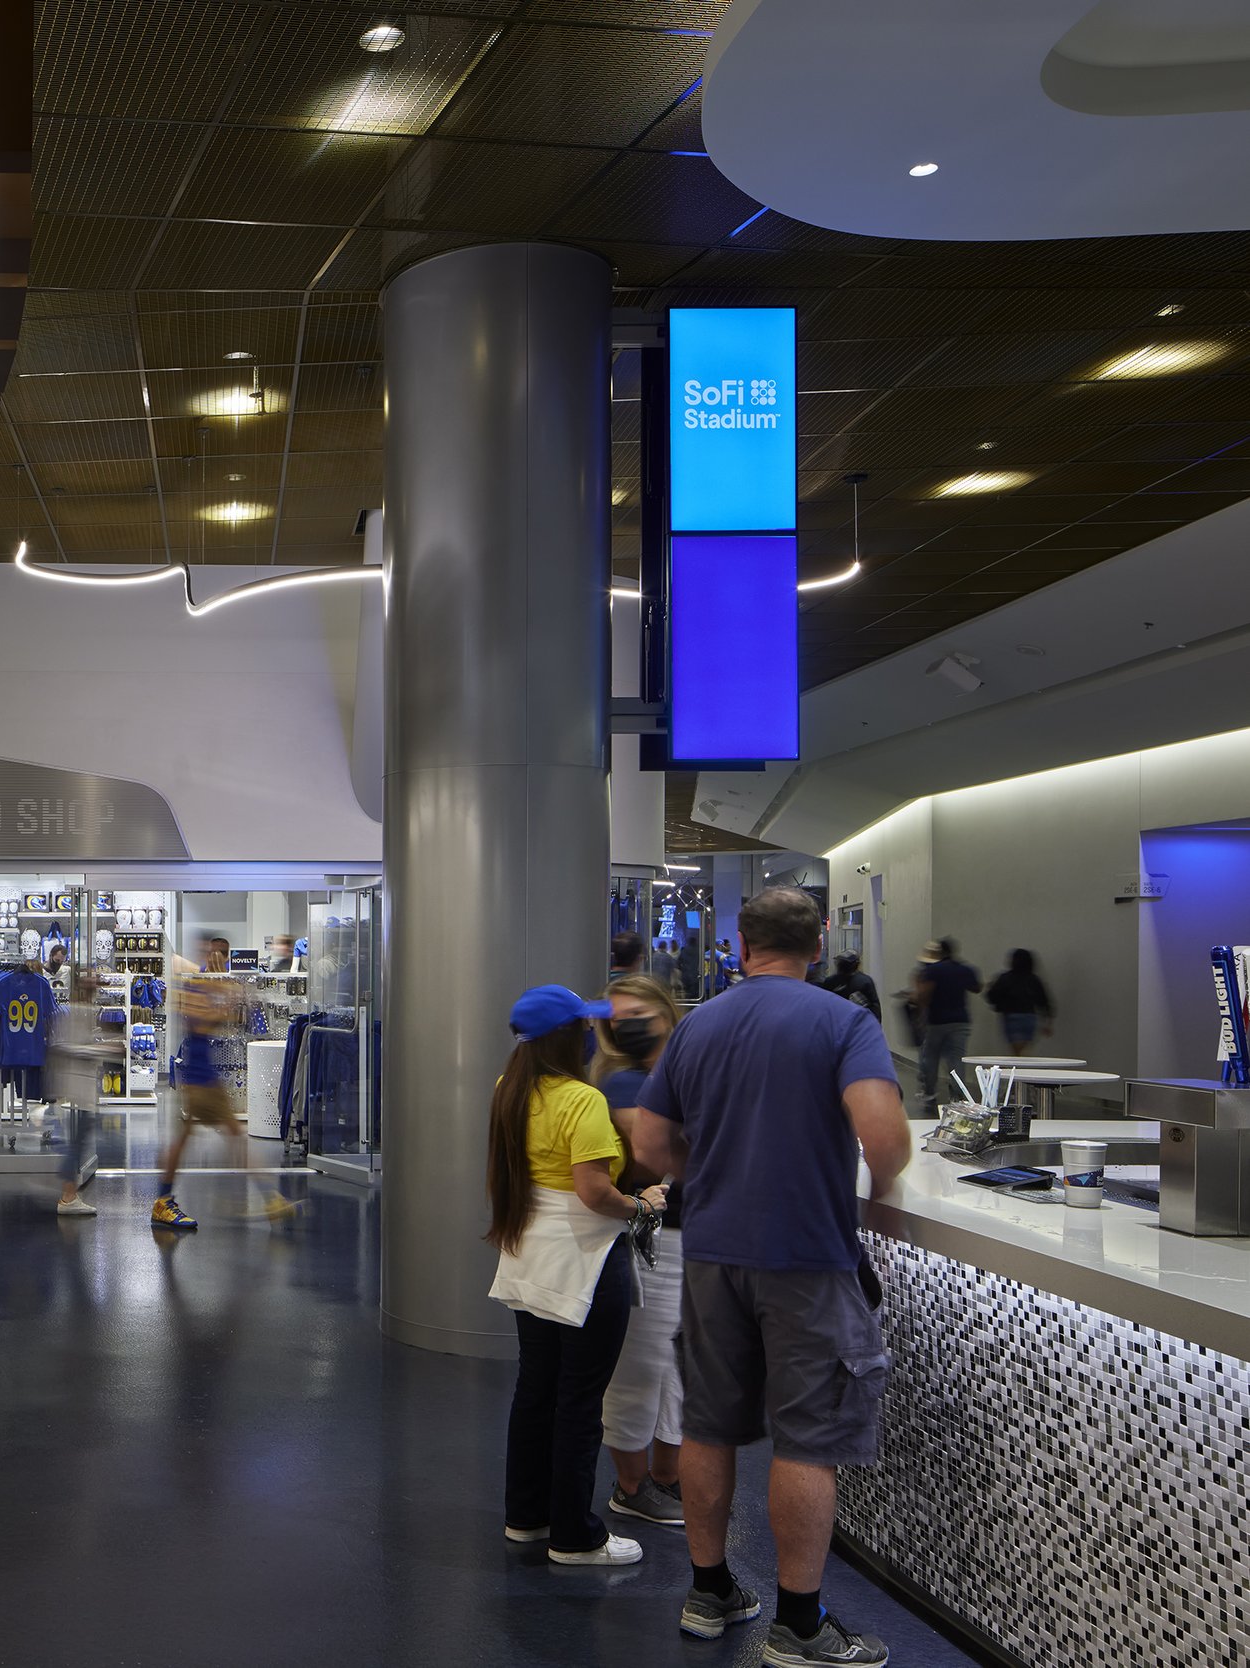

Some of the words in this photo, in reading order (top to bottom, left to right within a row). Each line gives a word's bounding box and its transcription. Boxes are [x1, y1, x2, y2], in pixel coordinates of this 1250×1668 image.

[684, 379, 744, 406] SoFi
[17, 799, 115, 835] SHOP
[1212, 965, 1231, 1016] LIGHT
[8, 1000, 38, 1033] 99
[1222, 1017, 1238, 1054] BUD
